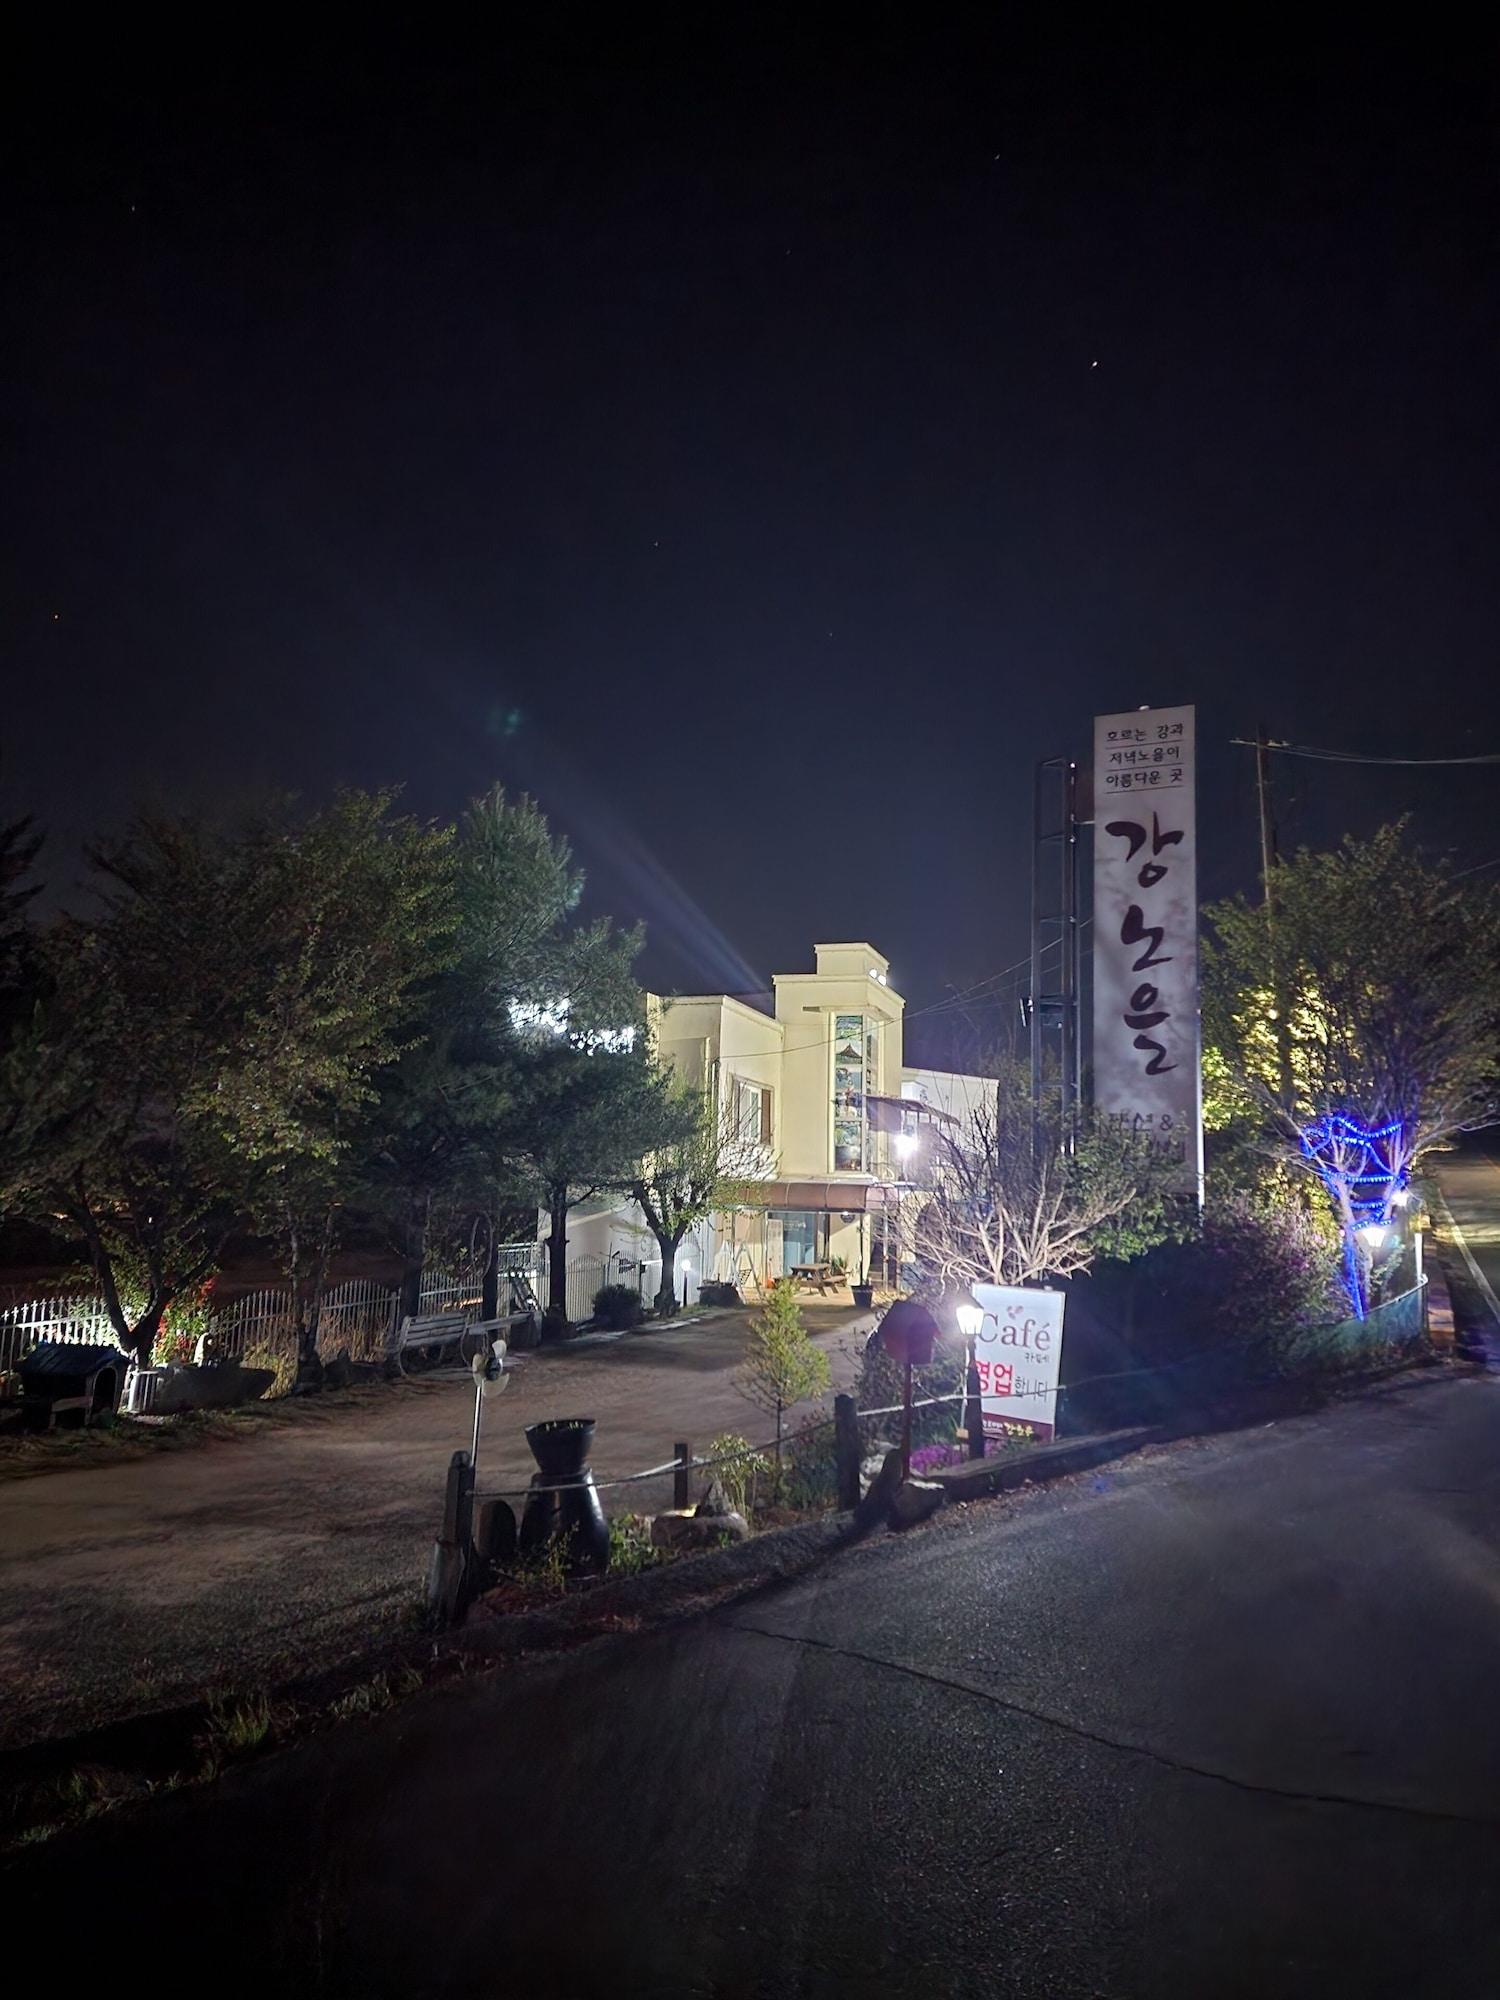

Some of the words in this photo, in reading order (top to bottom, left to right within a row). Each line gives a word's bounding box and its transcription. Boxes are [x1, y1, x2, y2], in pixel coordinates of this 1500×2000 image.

[1107, 728, 1147, 741] 흐르는
[1157, 723, 1183, 739] 강과
[1110, 746, 1179, 764] 저녁노을이
[1106, 771, 1160, 787] 아름다운
[1170, 769, 1183, 783] 곳
[1105, 811, 1184, 1076] 강노을
[977, 1313, 1050, 1351] Café
